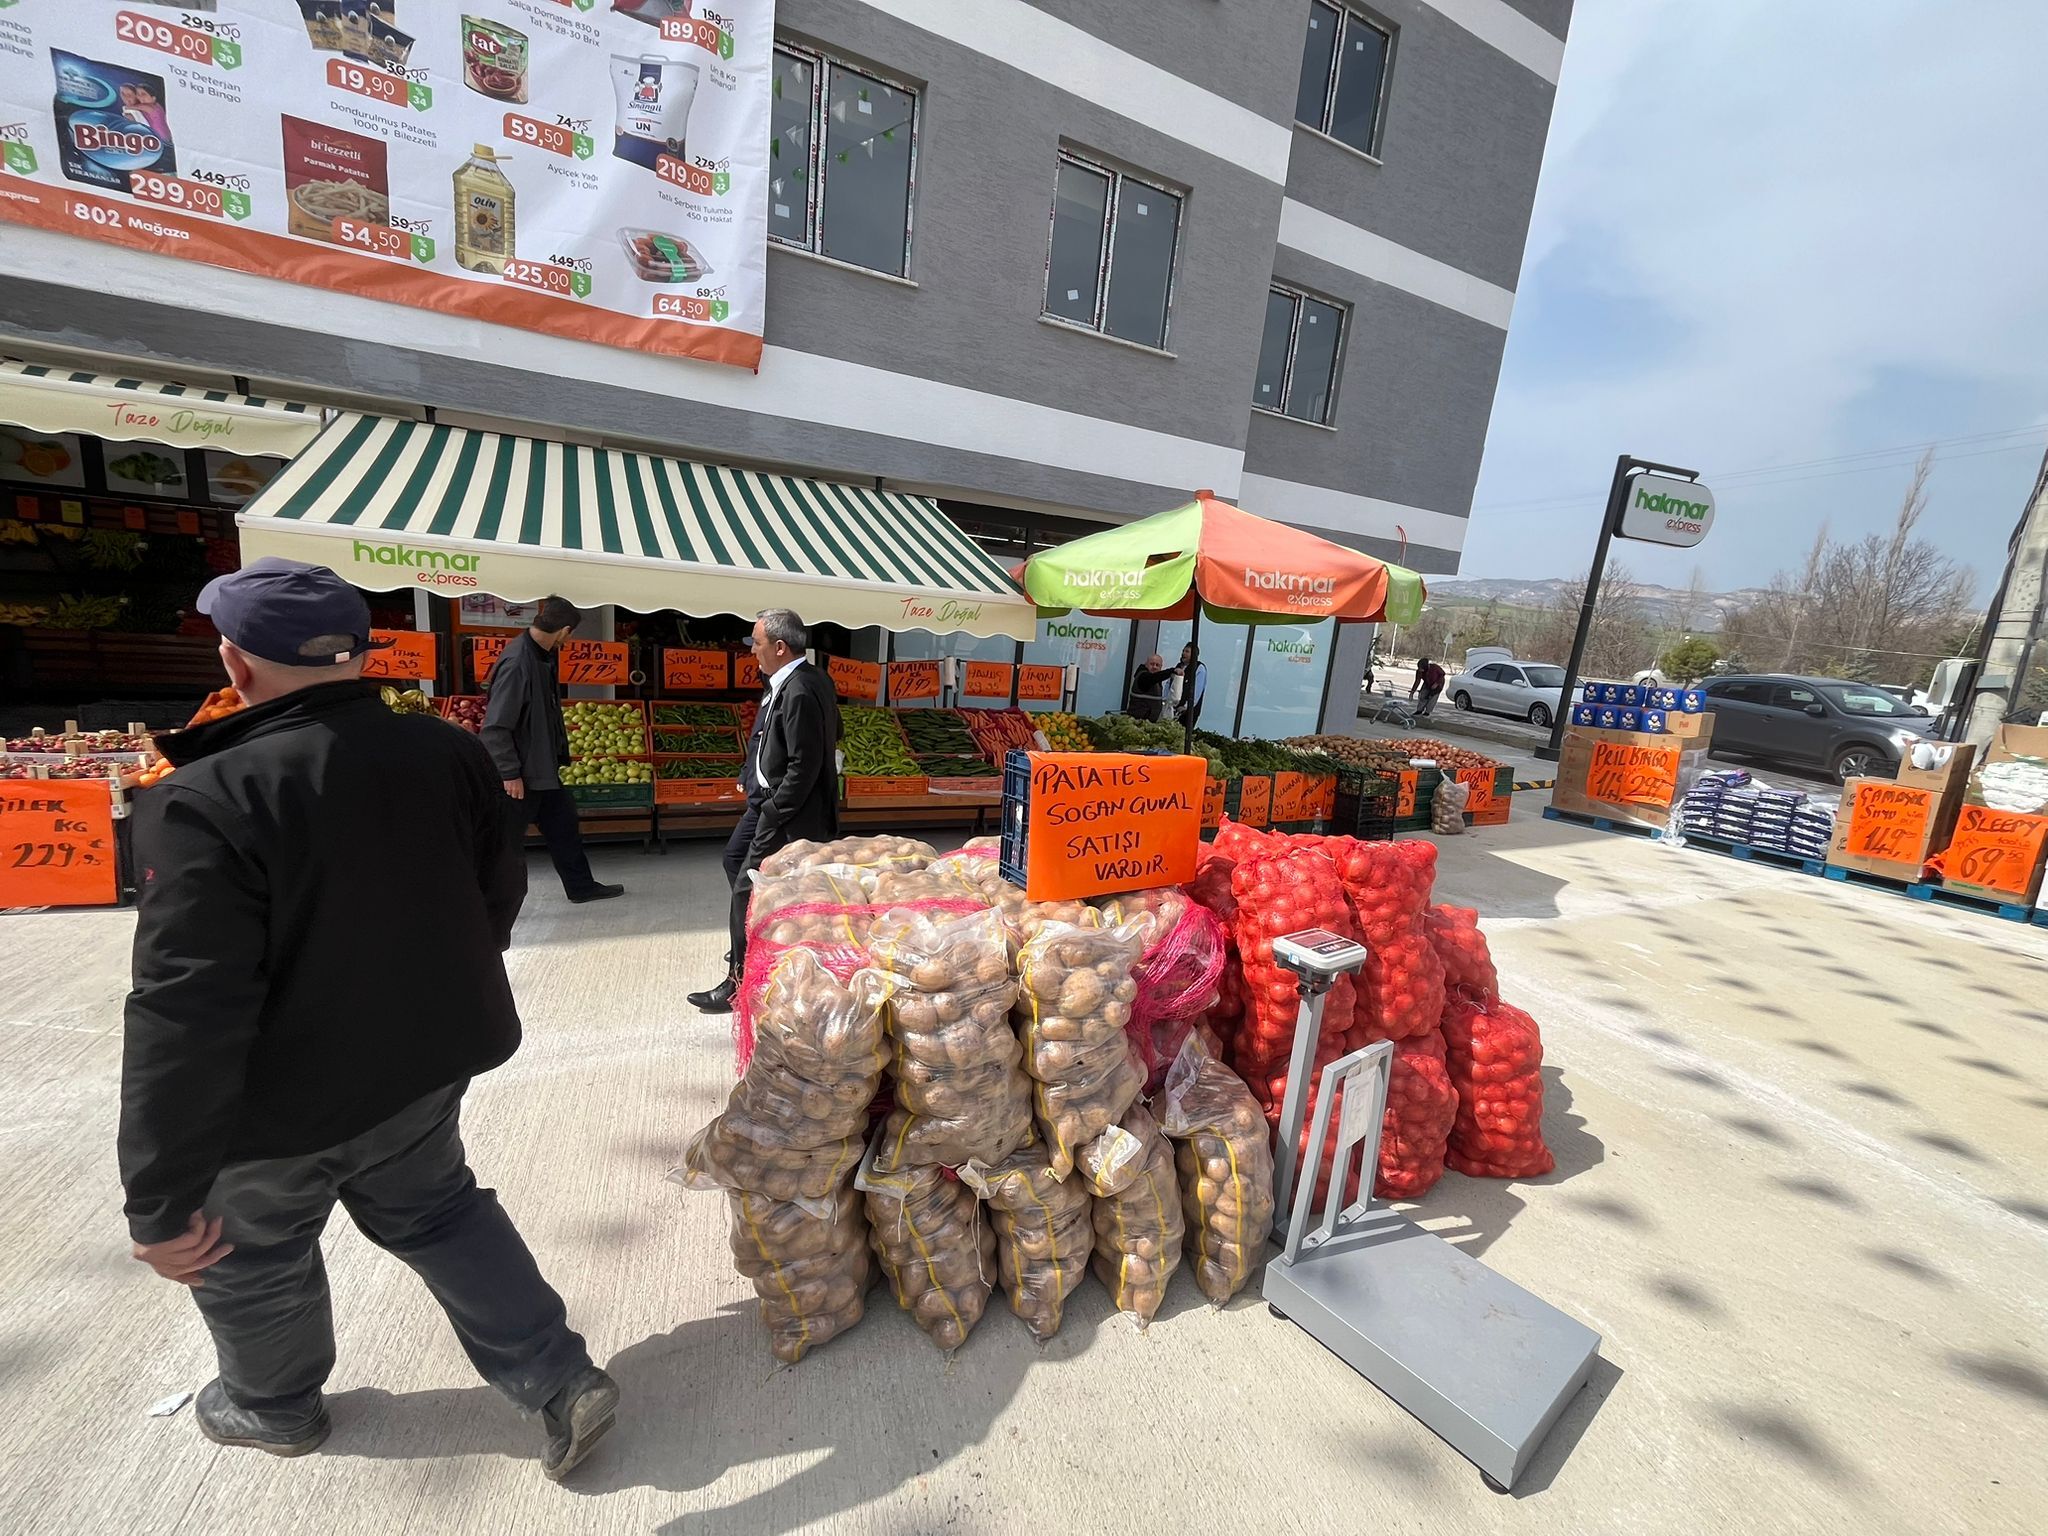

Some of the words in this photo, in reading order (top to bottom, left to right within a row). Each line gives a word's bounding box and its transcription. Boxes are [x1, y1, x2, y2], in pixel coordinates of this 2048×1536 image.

[181, 12, 241, 39] 299,00
[534, 6, 573, 28] Domates
[575, 20, 592, 33] 830
[661, 19, 716, 45] 189,00
[118, 14, 208, 55] 209,00
[471, 33, 498, 54] tat
[555, 23, 581, 41] 28-30
[583, 34, 600, 48] Brix
[218, 51, 236, 65] 30
[167, 63, 189, 78] Toz
[191, 70, 242, 93] Deterjan
[178, 78, 188, 89] 9
[190, 81, 205, 95] kg
[207, 86, 242, 103] Bingo
[337, 65, 396, 95] 19,90
[412, 95, 427, 107] 34
[330, 101, 399, 129] Dondurulmuş
[401, 121, 437, 139] Patates
[353, 118, 380, 132] 1000
[381, 127, 389, 136] g
[511, 118, 564, 146] 59,50
[635, 122, 651, 132] UN
[73, 122, 162, 156] Bingo
[577, 145, 590, 156] 20
[191, 168, 250, 190] 449,00
[303, 156, 338, 172] Parmak
[338, 165, 370, 179] Patates
[658, 158, 709, 189] 219,00
[129, 173, 221, 209] 299,00
[715, 183, 726, 191] 22
[73, 202, 123, 228] 802
[127, 215, 191, 240] Mağaza
[228, 203, 246, 216] 33
[686, 211, 701, 221] 450
[340, 221, 401, 250] 54,50
[418, 247, 427, 257] 8
[504, 262, 569, 289] 425,00
[578, 283, 585, 293] 5
[658, 298, 704, 316] 64,50
[106, 402, 160, 427] Taze
[166, 409, 235, 440] Doğal
[1634, 487, 1710, 521] hakmar
[1666, 517, 1702, 534] express
[353, 540, 481, 572] hakmar
[416, 569, 478, 587] express
[1063, 568, 1147, 587] hakmar
[1243, 567, 1337, 594] hakmar
[1287, 591, 1334, 607] express
[900, 597, 935, 620] Taze
[936, 599, 983, 627] Doğal
[1046, 621, 1110, 640] hakmar
[1267, 638, 1316, 655] hakmar
[668, 671, 693, 687] 139
[1033, 763, 1151, 795] PATATES
[54, 818, 89, 832] KG
[1961, 809, 2042, 837] SLEEPY
[1066, 831, 1141, 859] SATIŞI
